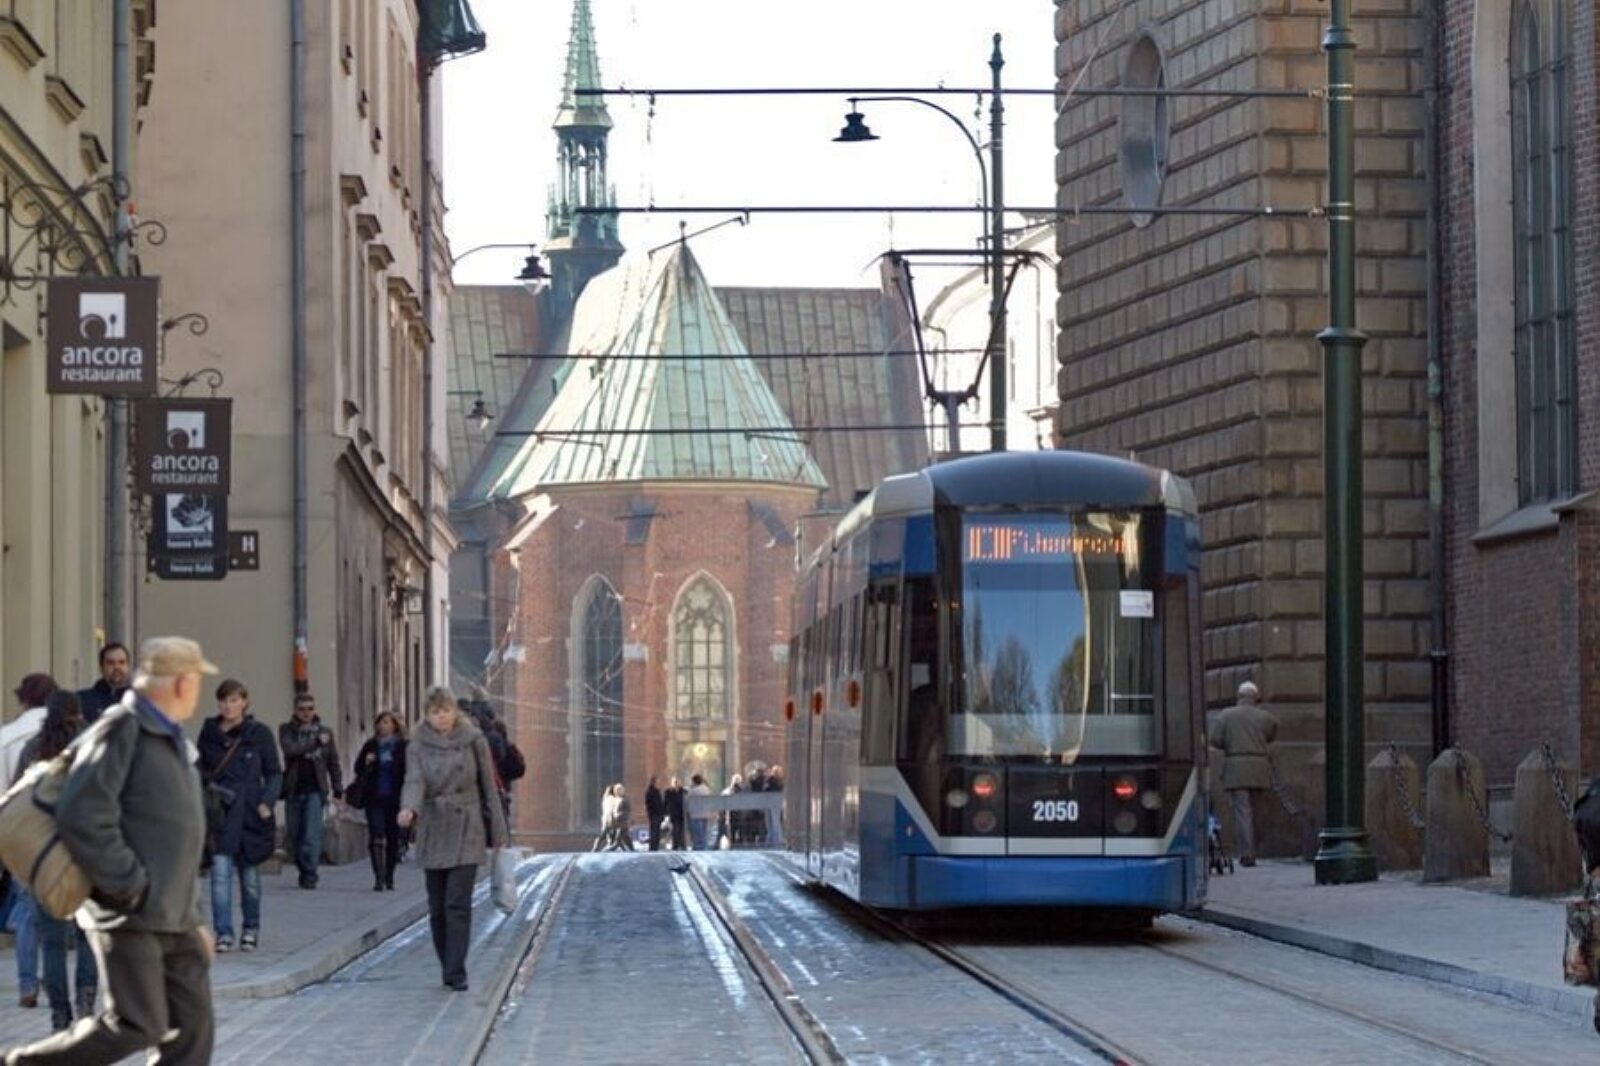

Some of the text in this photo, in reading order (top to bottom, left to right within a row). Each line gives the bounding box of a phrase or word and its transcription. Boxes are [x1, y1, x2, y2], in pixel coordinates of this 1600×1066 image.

[61, 347, 143, 365] ancora
[61, 367, 143, 382] restaurant
[151, 454, 219, 471] ancora
[151, 472, 219, 484] restaurant
[1032, 800, 1079, 822] 2050
